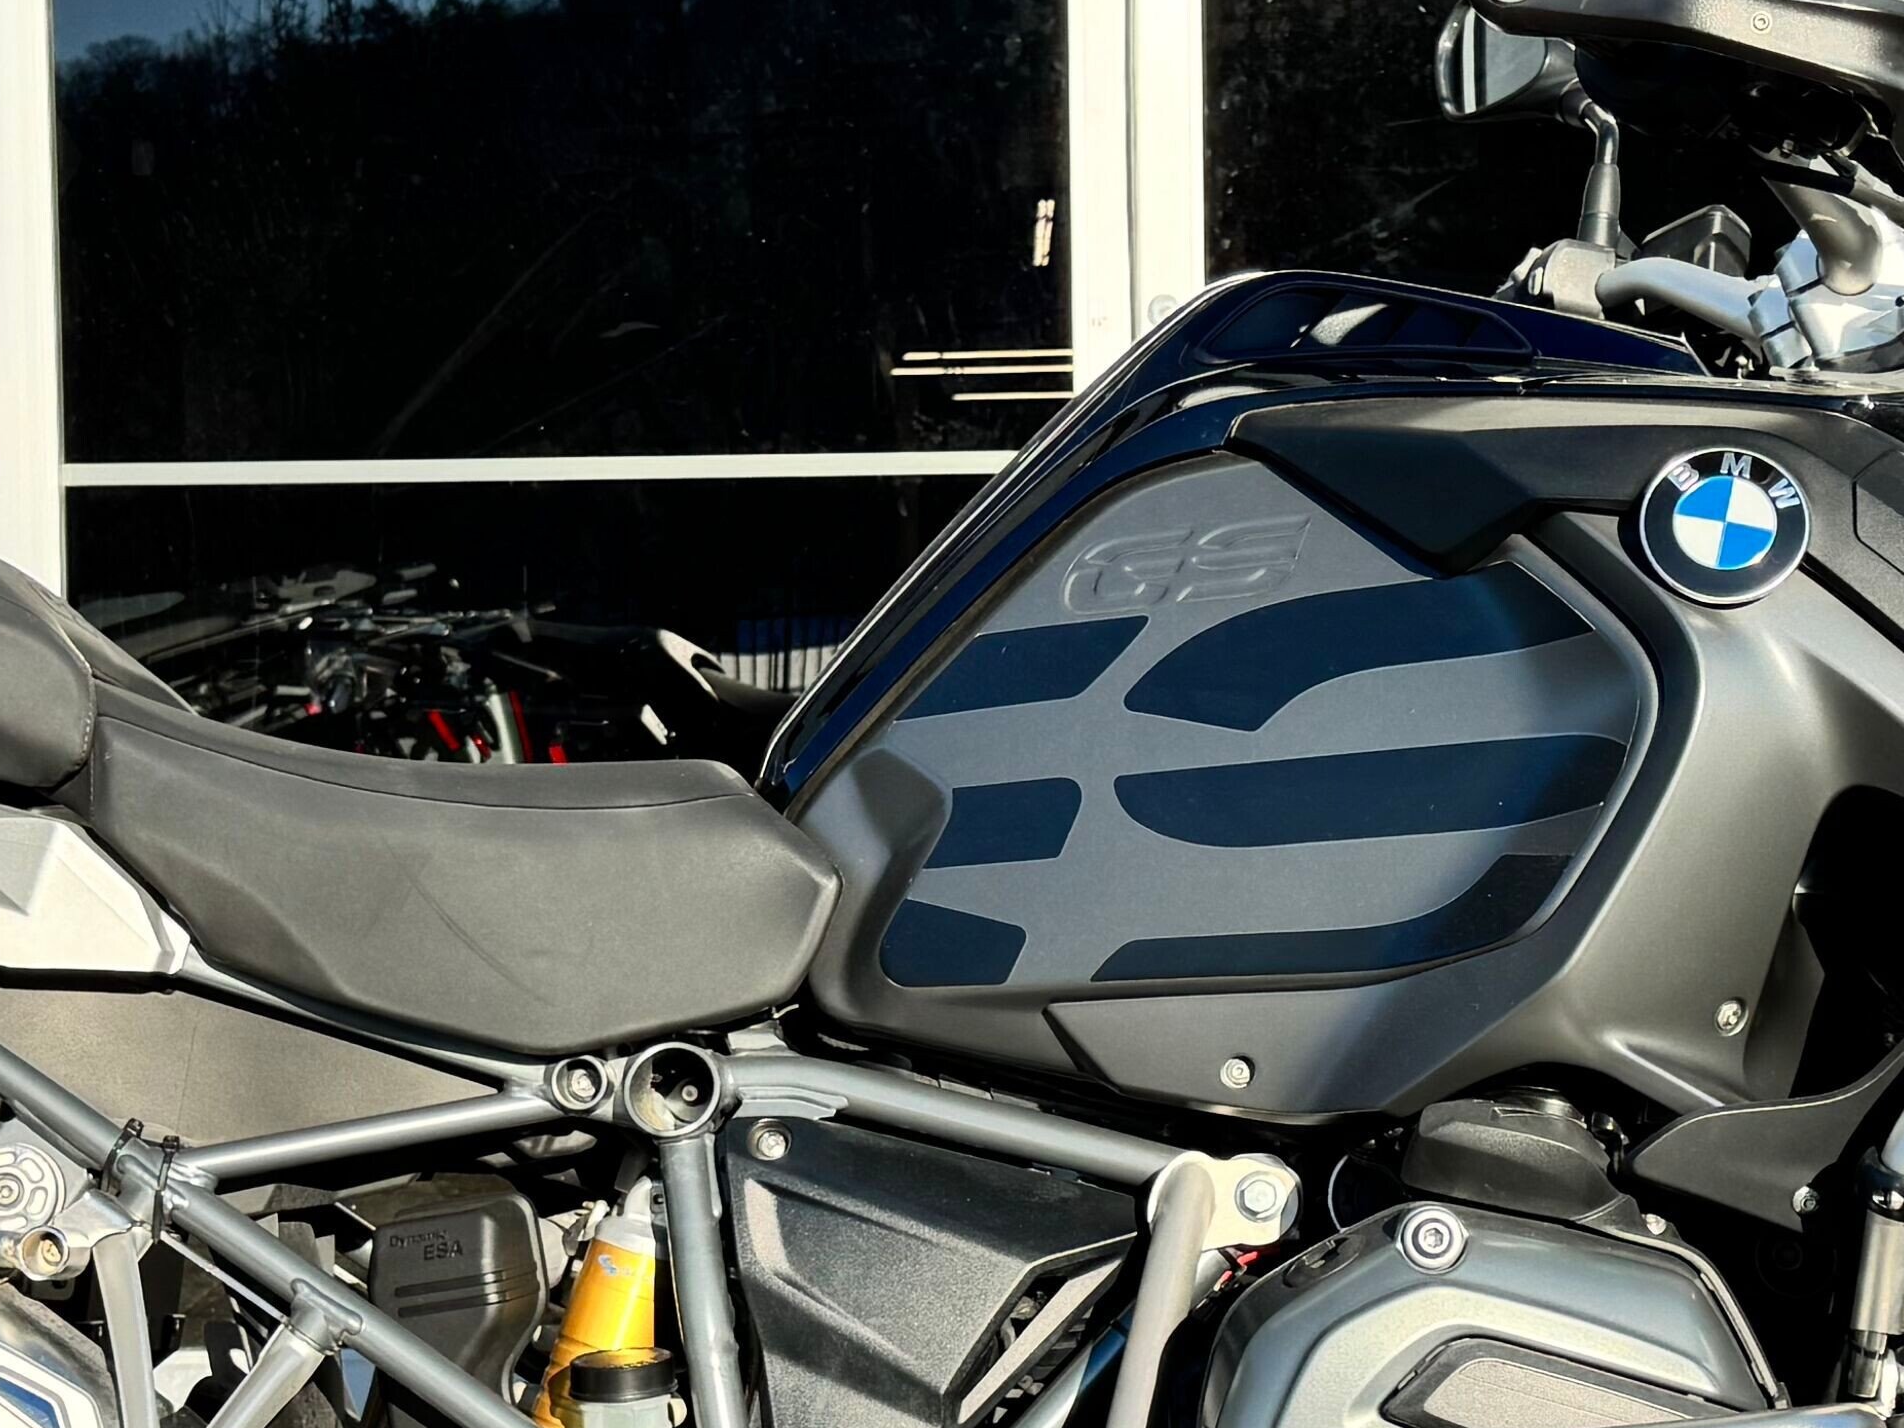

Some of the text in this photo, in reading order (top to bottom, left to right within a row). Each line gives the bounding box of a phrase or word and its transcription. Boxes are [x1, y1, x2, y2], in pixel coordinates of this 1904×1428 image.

[1668, 452, 1801, 510] BMW
[1061, 513, 1312, 617] GS
[423, 1239, 464, 1260] ESA
